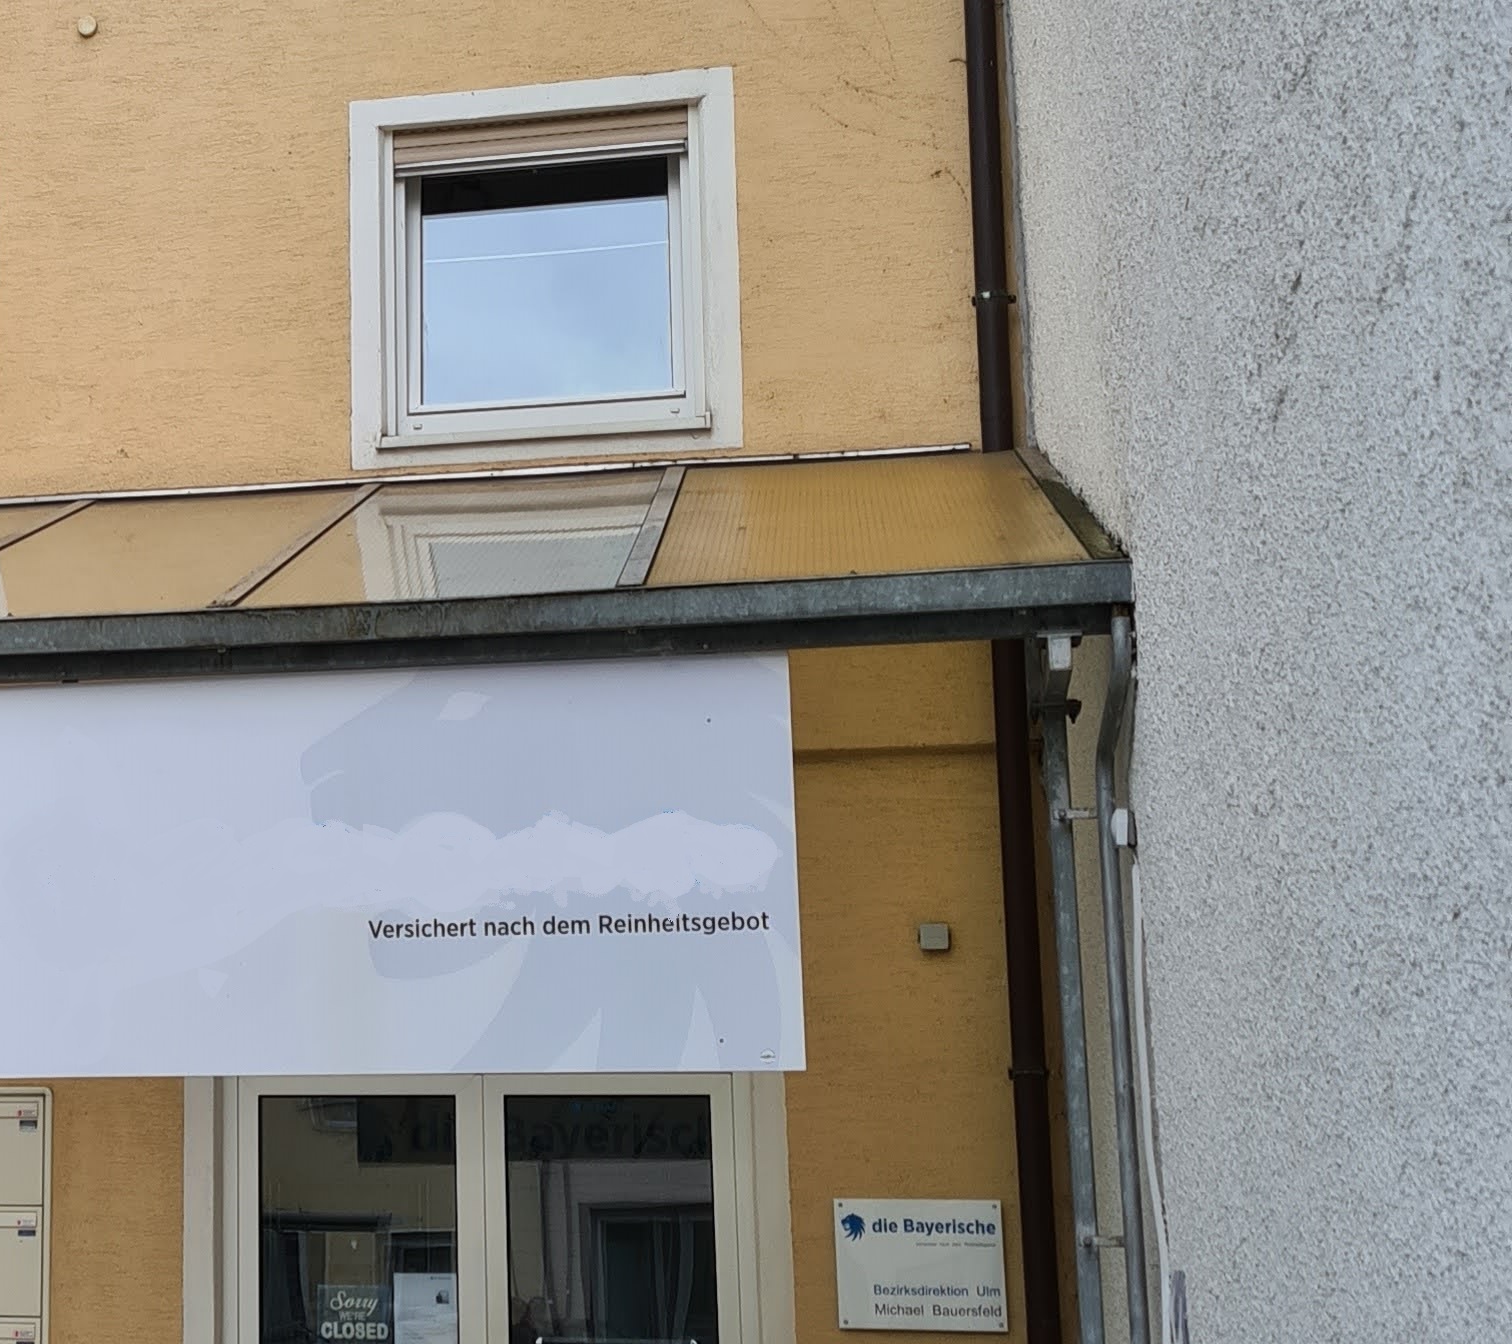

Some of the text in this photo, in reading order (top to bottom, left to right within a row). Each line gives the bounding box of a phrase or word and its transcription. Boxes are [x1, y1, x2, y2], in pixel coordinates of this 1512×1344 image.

[368, 912, 770, 939] Versichert nach dem Reinheitsgebot
[872, 1218, 996, 1236] die Bayerische
[873, 1284, 1001, 1297] Bezirksdirektion Ulm
[330, 1290, 378, 1316] Sorry
[874, 1304, 1002, 1317] Michael Bauersfeld
[321, 1321, 389, 1339] CLOSED
